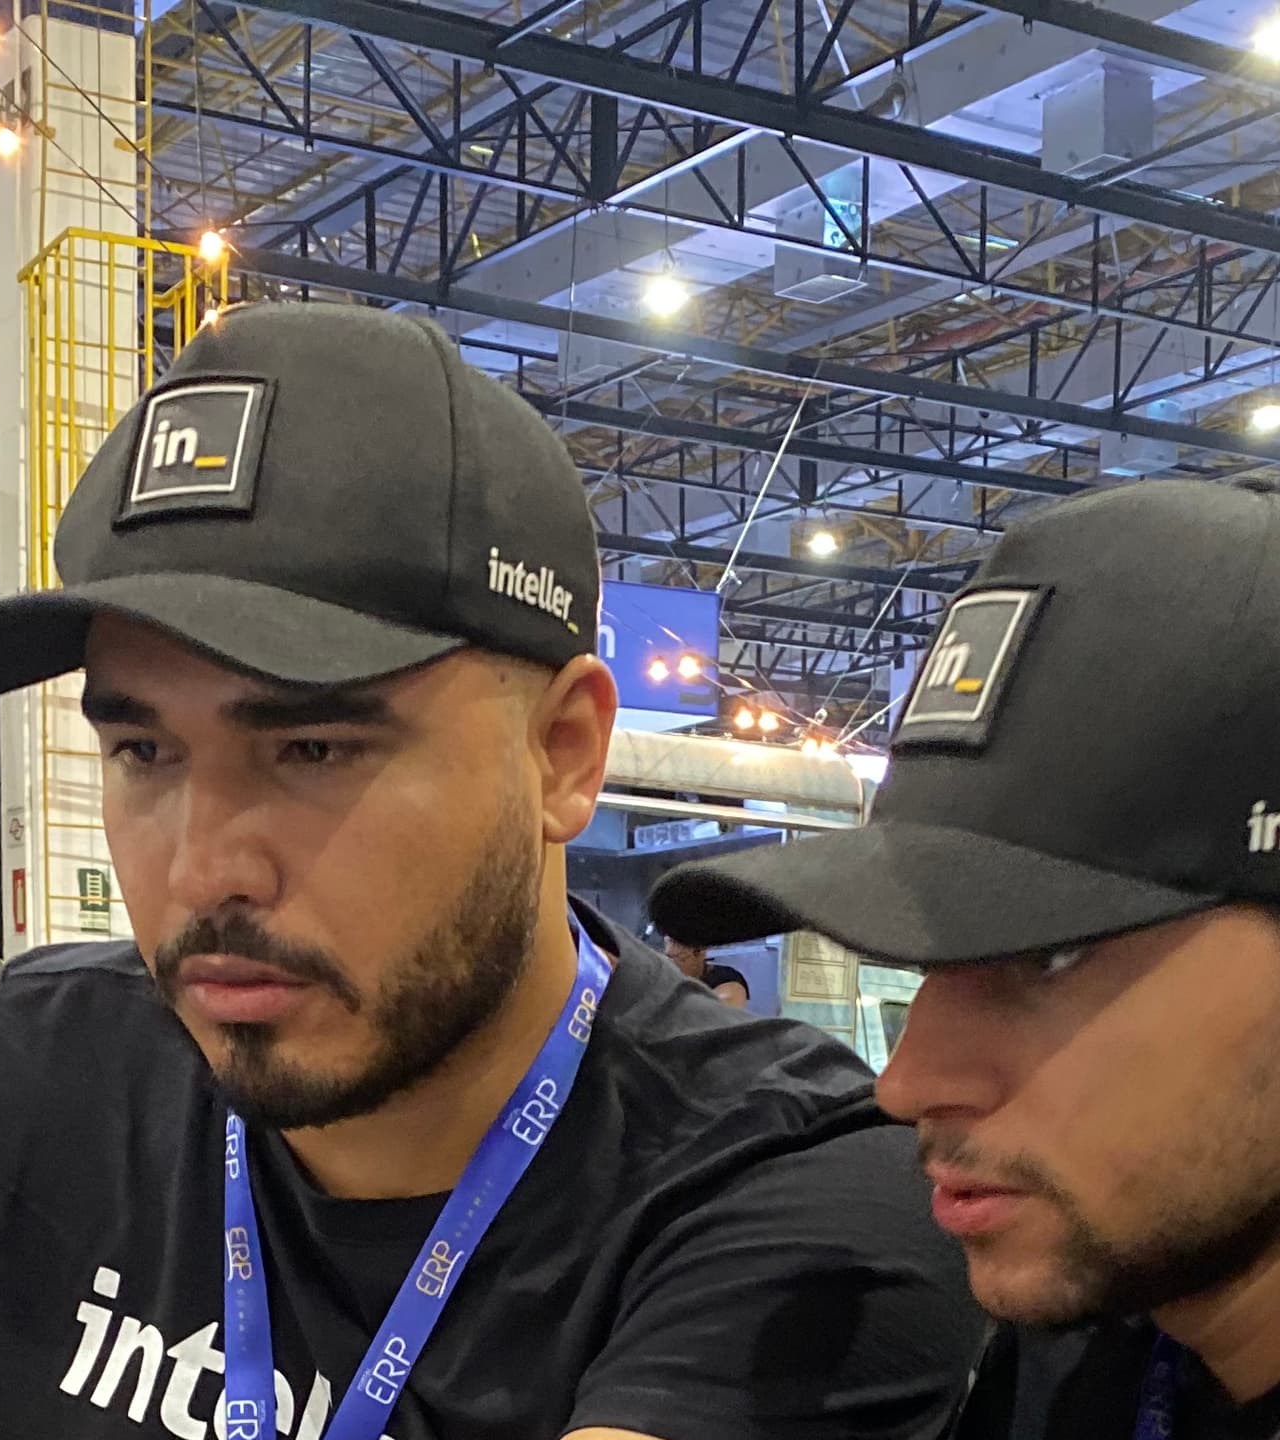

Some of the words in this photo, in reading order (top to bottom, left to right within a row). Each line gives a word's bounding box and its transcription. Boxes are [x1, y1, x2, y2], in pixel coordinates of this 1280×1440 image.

[568, 987, 597, 1044] ERP
[512, 1078, 560, 1146] ERP
[229, 1226, 252, 1280] ERP
[415, 1240, 451, 1297] ERP
[365, 1336, 411, 1405] ERP
